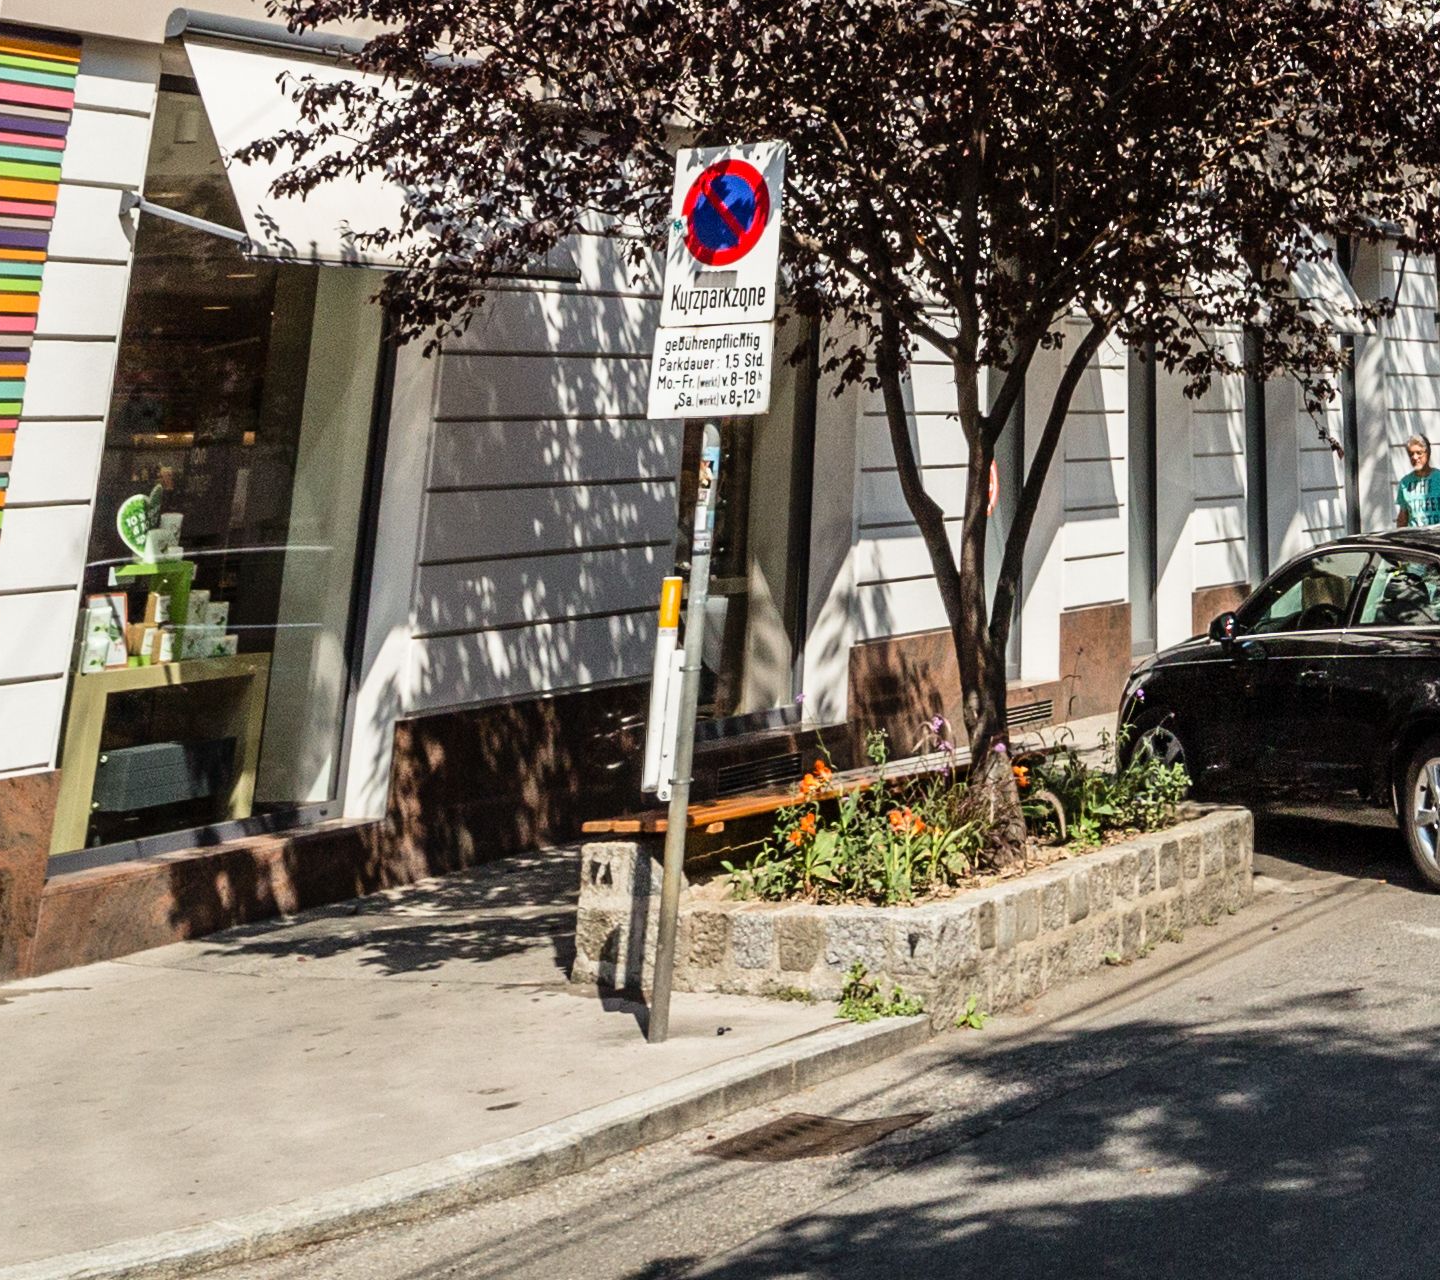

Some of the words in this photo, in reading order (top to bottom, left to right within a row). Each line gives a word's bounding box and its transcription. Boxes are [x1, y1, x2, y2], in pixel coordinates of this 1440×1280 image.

[670, 284, 766, 316] Kurzparkzone
[665, 332, 761, 356] gebührenpflichtig
[744, 352, 766, 368] Std.
[677, 392, 695, 407] Sa.
